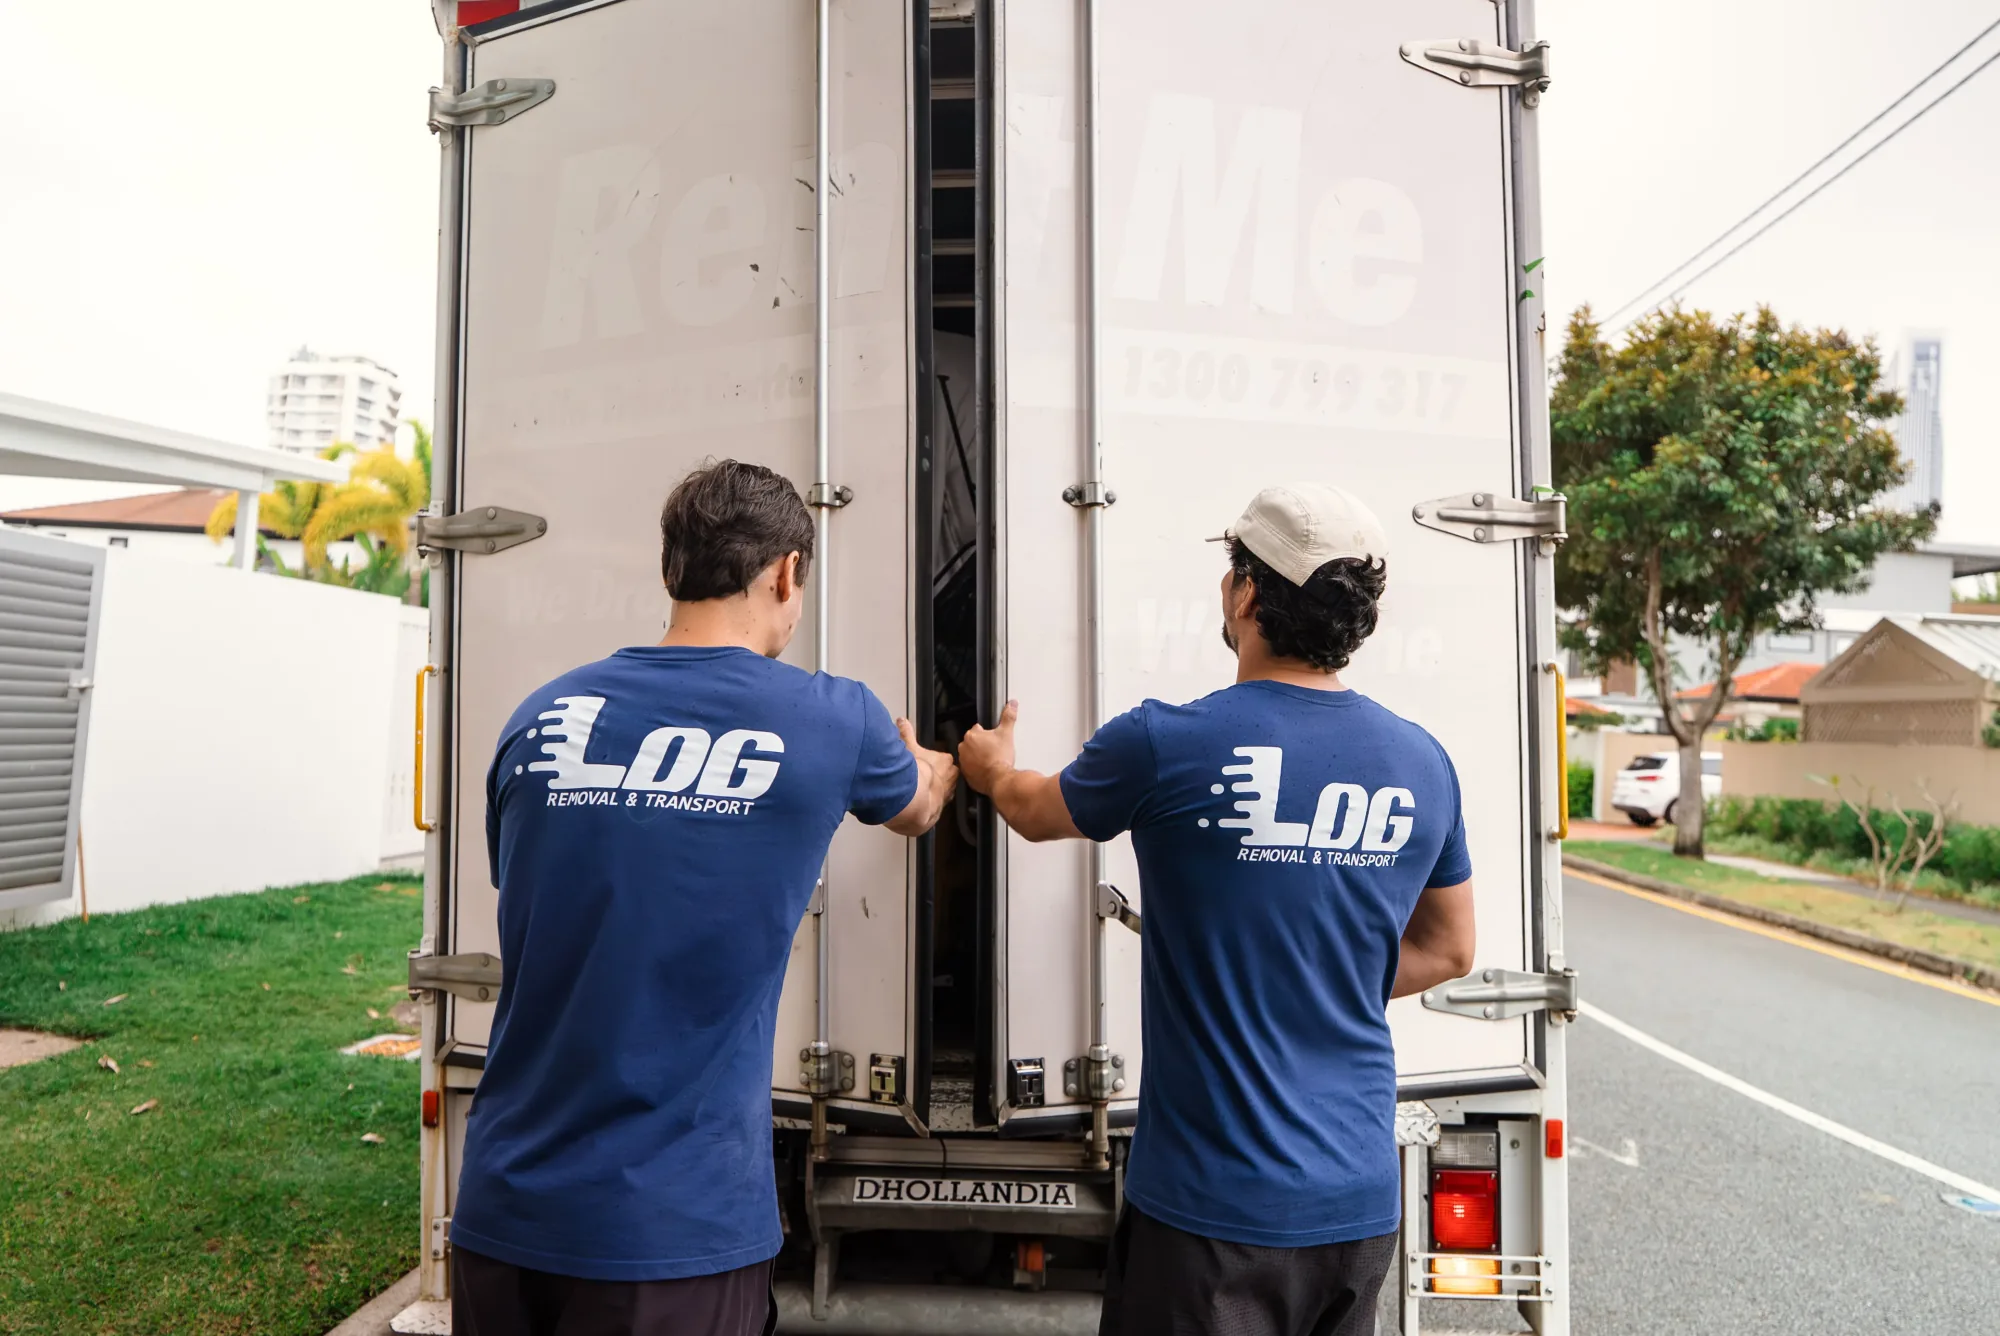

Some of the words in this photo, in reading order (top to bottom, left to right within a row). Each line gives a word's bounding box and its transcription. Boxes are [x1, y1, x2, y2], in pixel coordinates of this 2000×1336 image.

[1112, 91, 1423, 326] Me
[1123, 345, 1251, 404] 1300
[1268, 355, 1365, 413] 799
[1375, 366, 1469, 422] 317
[582, 568, 667, 622] Dro
[528, 695, 785, 800] LOG
[547, 790, 618, 807] REMOVAL
[625, 792, 638, 807] &
[645, 793, 755, 816] TRANSPORT
[1217, 746, 1416, 852] LOG
[1237, 847, 1307, 864] REMOVAL
[1312, 850, 1322, 865] &
[1327, 851, 1399, 867] TRANSPORT
[856, 1178, 1074, 1206] DHOLLANDIA
